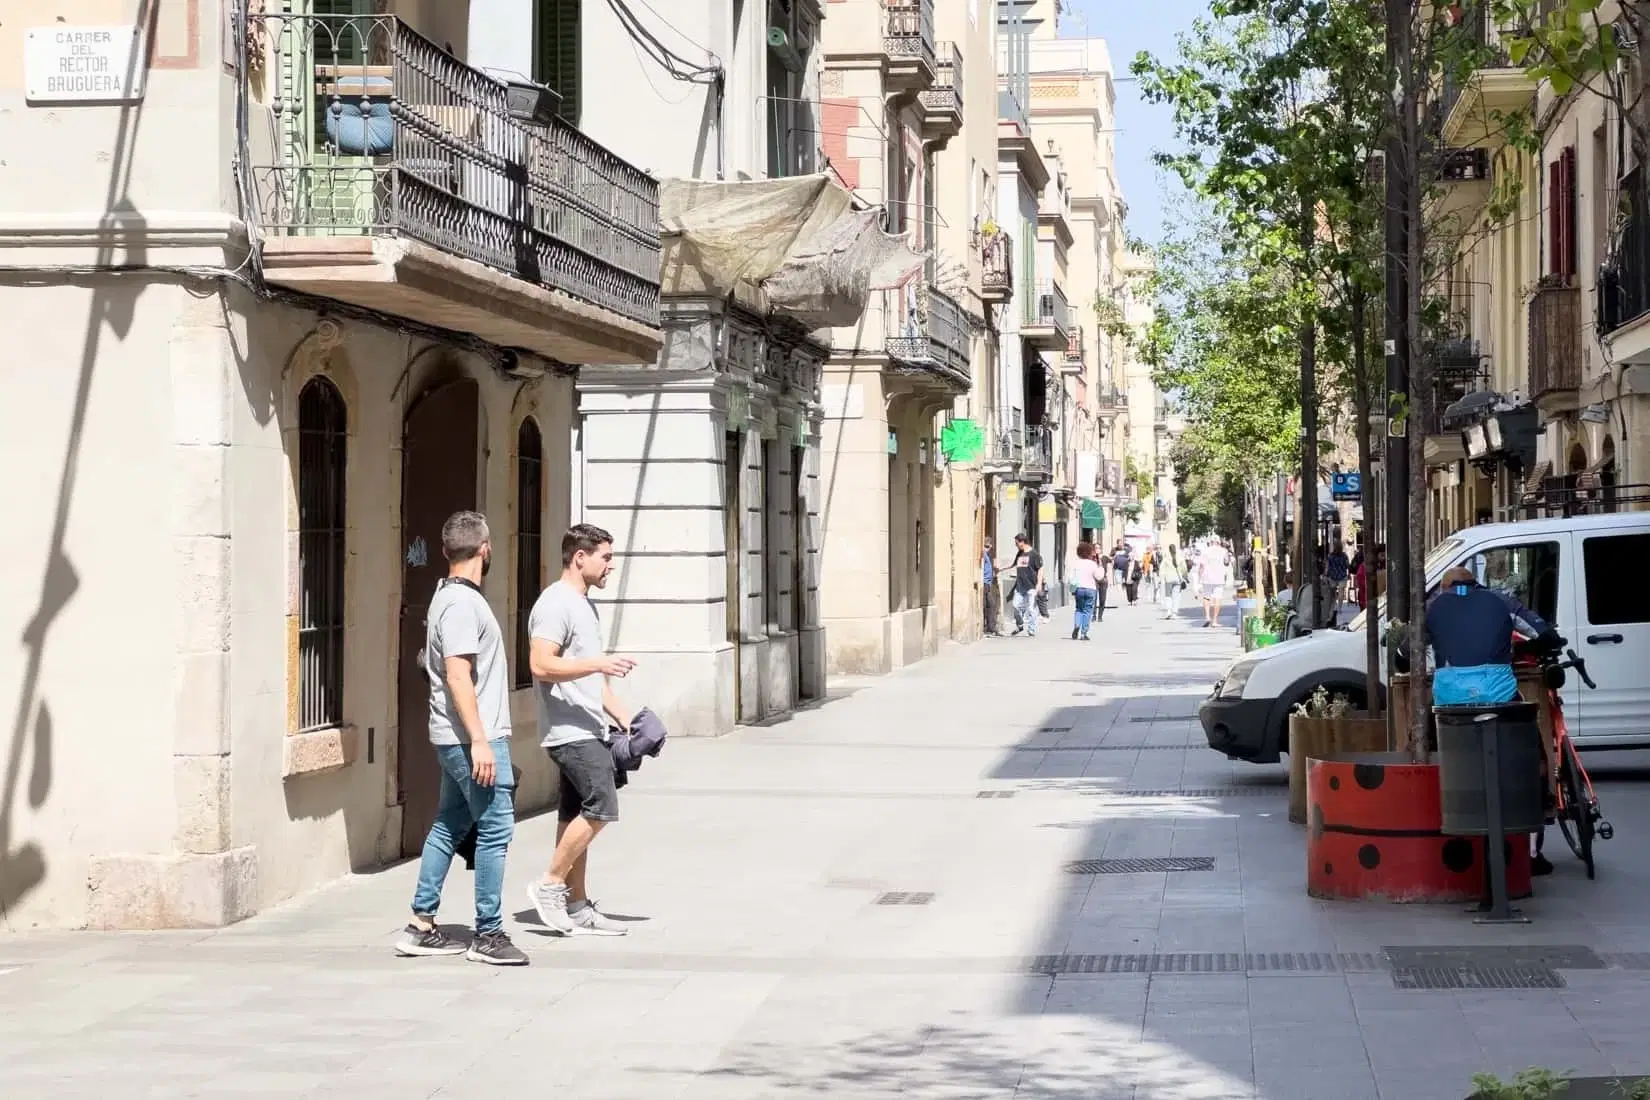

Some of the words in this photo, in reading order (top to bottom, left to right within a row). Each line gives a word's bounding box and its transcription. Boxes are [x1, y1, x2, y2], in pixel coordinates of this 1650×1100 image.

[56, 31, 112, 44] CARRER
[71, 44, 96, 55] DEL
[59, 55, 108, 73] RECTOR
[47, 74, 121, 92] BRUGUERA
